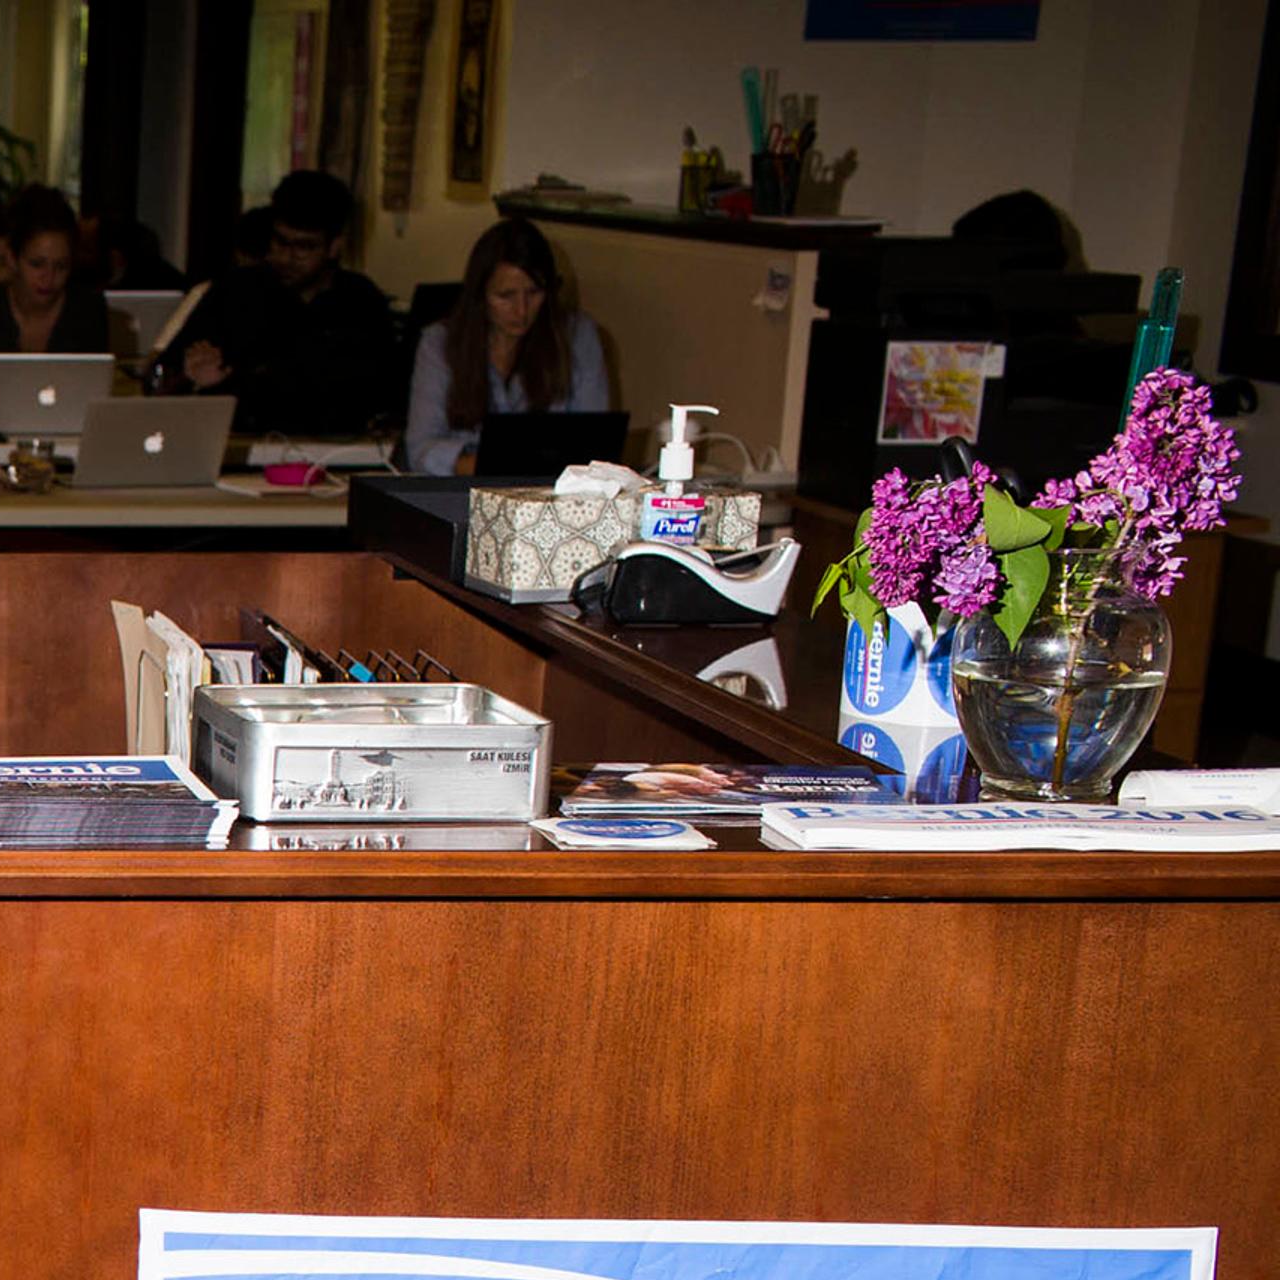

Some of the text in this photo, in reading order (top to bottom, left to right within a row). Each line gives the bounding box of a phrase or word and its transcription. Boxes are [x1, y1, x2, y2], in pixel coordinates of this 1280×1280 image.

[658, 517, 697, 534] Purell
[756, 782, 879, 792] Bernie
[778, 804, 1268, 820] Bernie 2016
